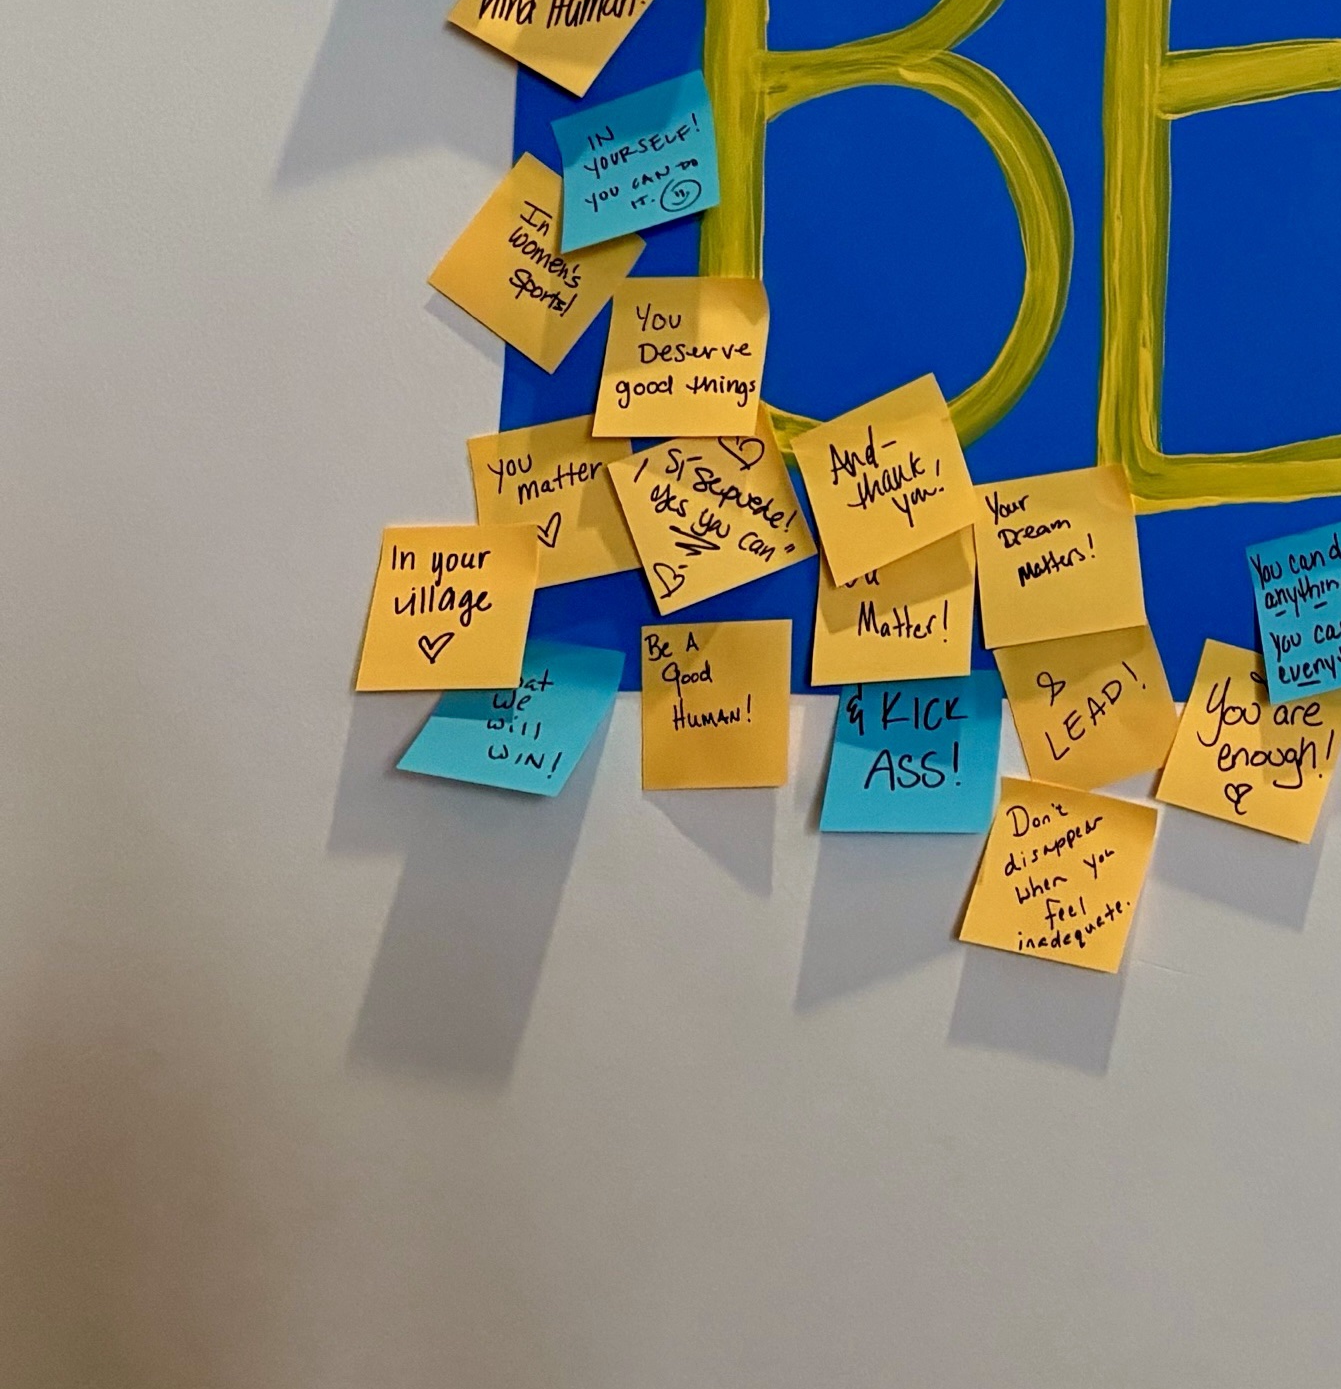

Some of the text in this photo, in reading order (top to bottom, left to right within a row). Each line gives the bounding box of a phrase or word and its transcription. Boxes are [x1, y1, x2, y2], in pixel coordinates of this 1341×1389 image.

[584, 113, 700, 179] YOURSELF!
[588, 125, 614, 150] IN
[616, 375, 756, 408] good things
[517, 461, 602, 506] matter
[985, 490, 1029, 525] Your
[998, 519, 1070, 549] Dream
[432, 548, 491, 587] your
[1250, 551, 1325, 590] You can
[395, 588, 492, 627] village
[857, 600, 949, 644] Matter!
[645, 634, 673, 661] Be
[672, 695, 752, 731] HUMAN!
[882, 692, 969, 731] KICK
[1045, 662, 1146, 761] LEAD!
[1197, 677, 1261, 747] You
[488, 744, 563, 778] WIN!
[864, 741, 961, 790] ASS!
[1217, 730, 1335, 789] enough!
[1011, 804, 1068, 838] Don't
[1005, 817, 1103, 877] disappear
[1015, 874, 1067, 905] when
[1017, 900, 1131, 952] inadequate.
[1045, 896, 1085, 931] feel
